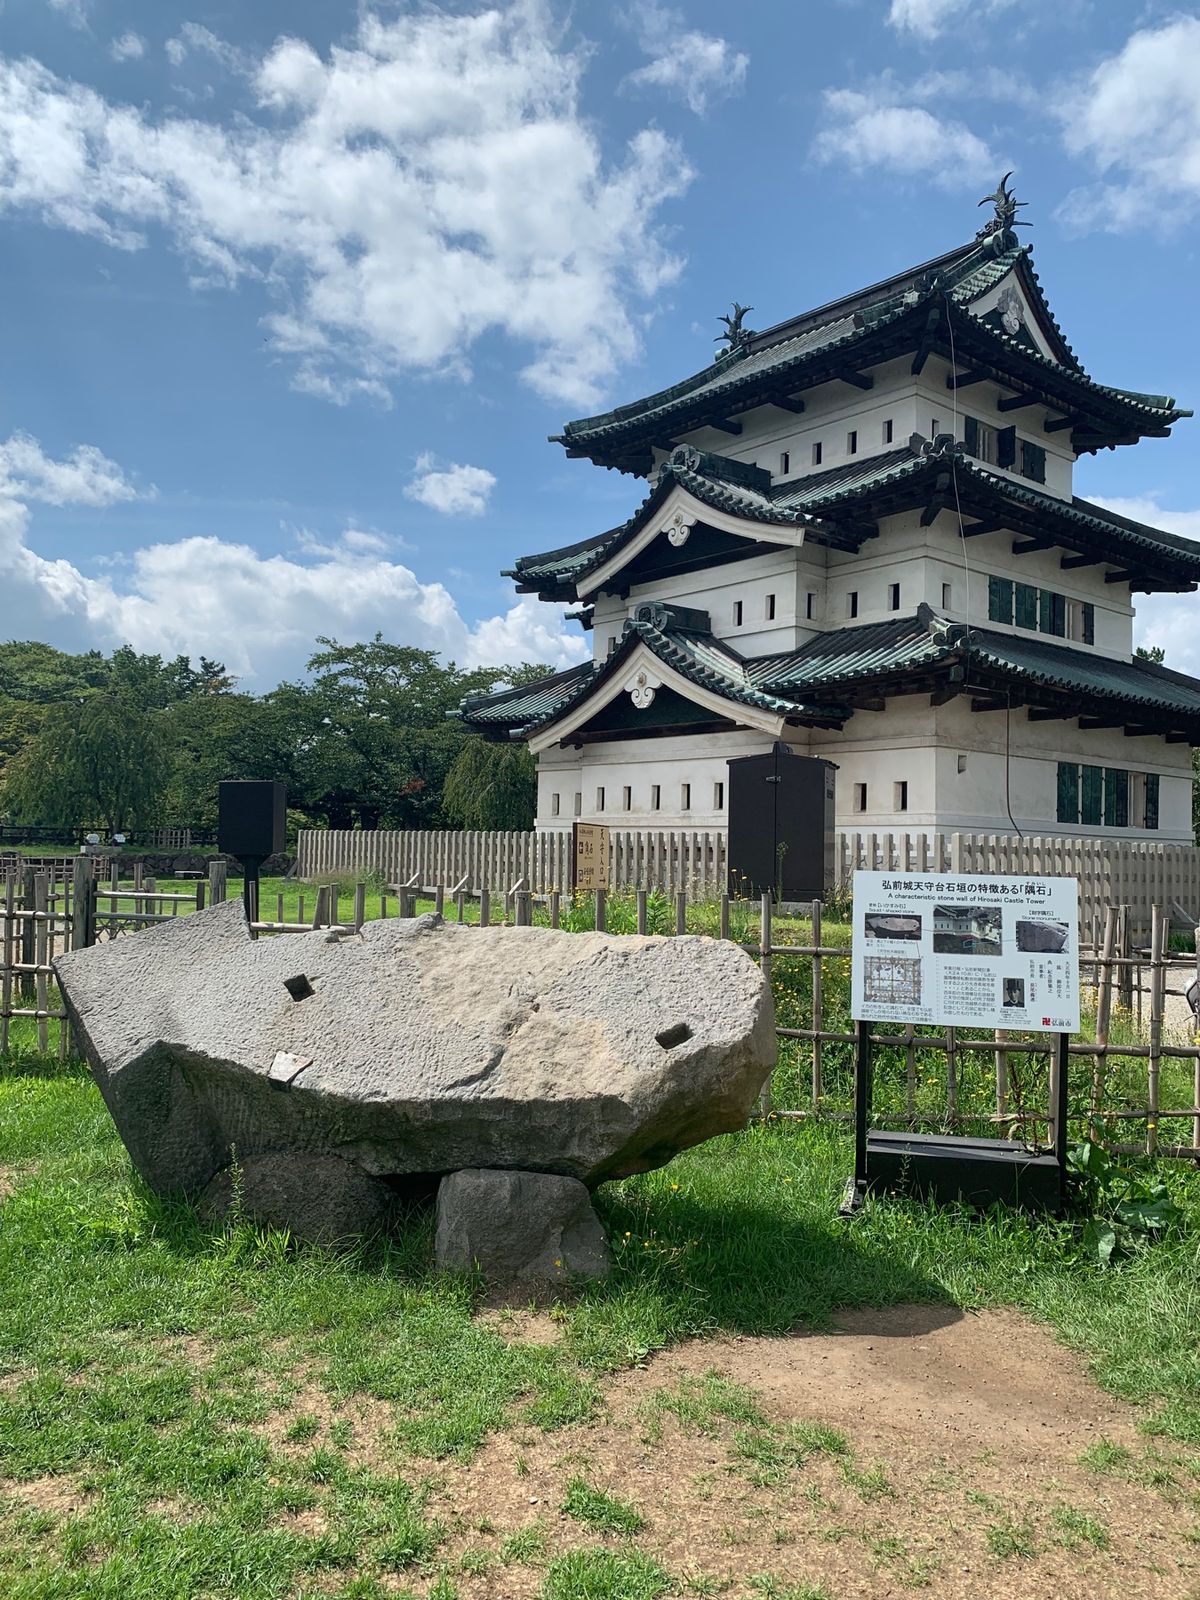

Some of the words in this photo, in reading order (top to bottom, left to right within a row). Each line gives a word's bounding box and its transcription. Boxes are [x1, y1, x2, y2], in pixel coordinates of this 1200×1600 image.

[882, 879, 1052, 897] 弘前城天守台石垣の特徴ある「隅石」
[894, 893, 936, 901] characteristic
